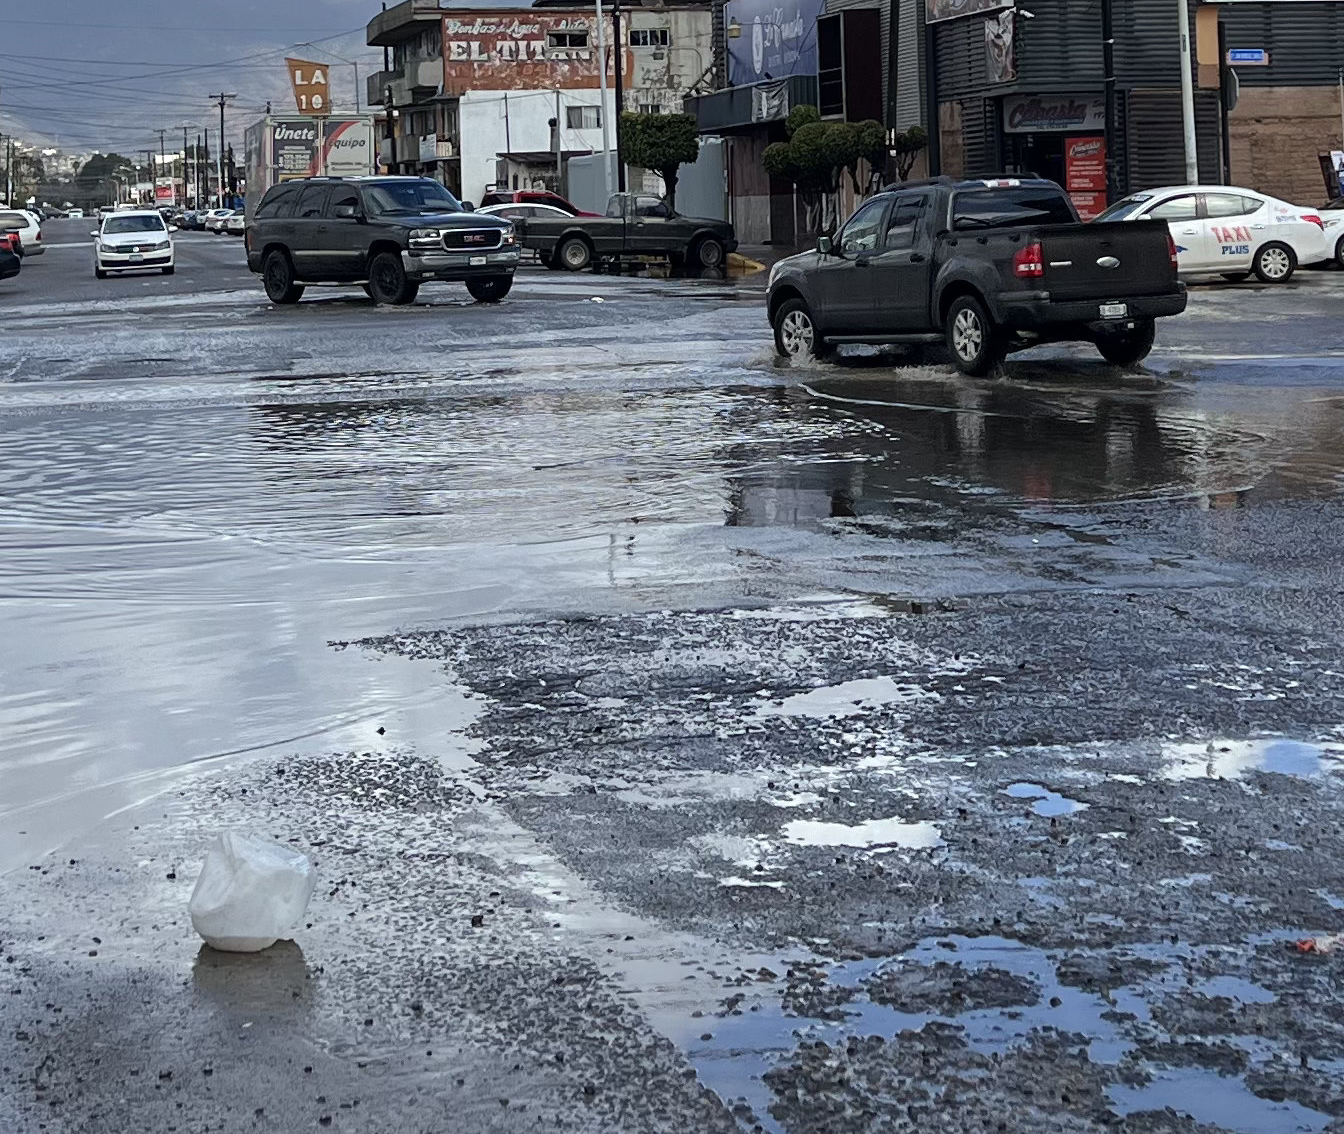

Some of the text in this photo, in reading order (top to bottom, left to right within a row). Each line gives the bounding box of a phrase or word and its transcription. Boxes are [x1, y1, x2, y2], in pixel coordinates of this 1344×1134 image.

[448, 40, 489, 61] EL
[294, 69, 327, 85] LA
[299, 94, 323, 110] 10
[274, 123, 316, 140] Únete
[1210, 226, 1253, 243] TAXI
[1221, 245, 1250, 255] PLUS
